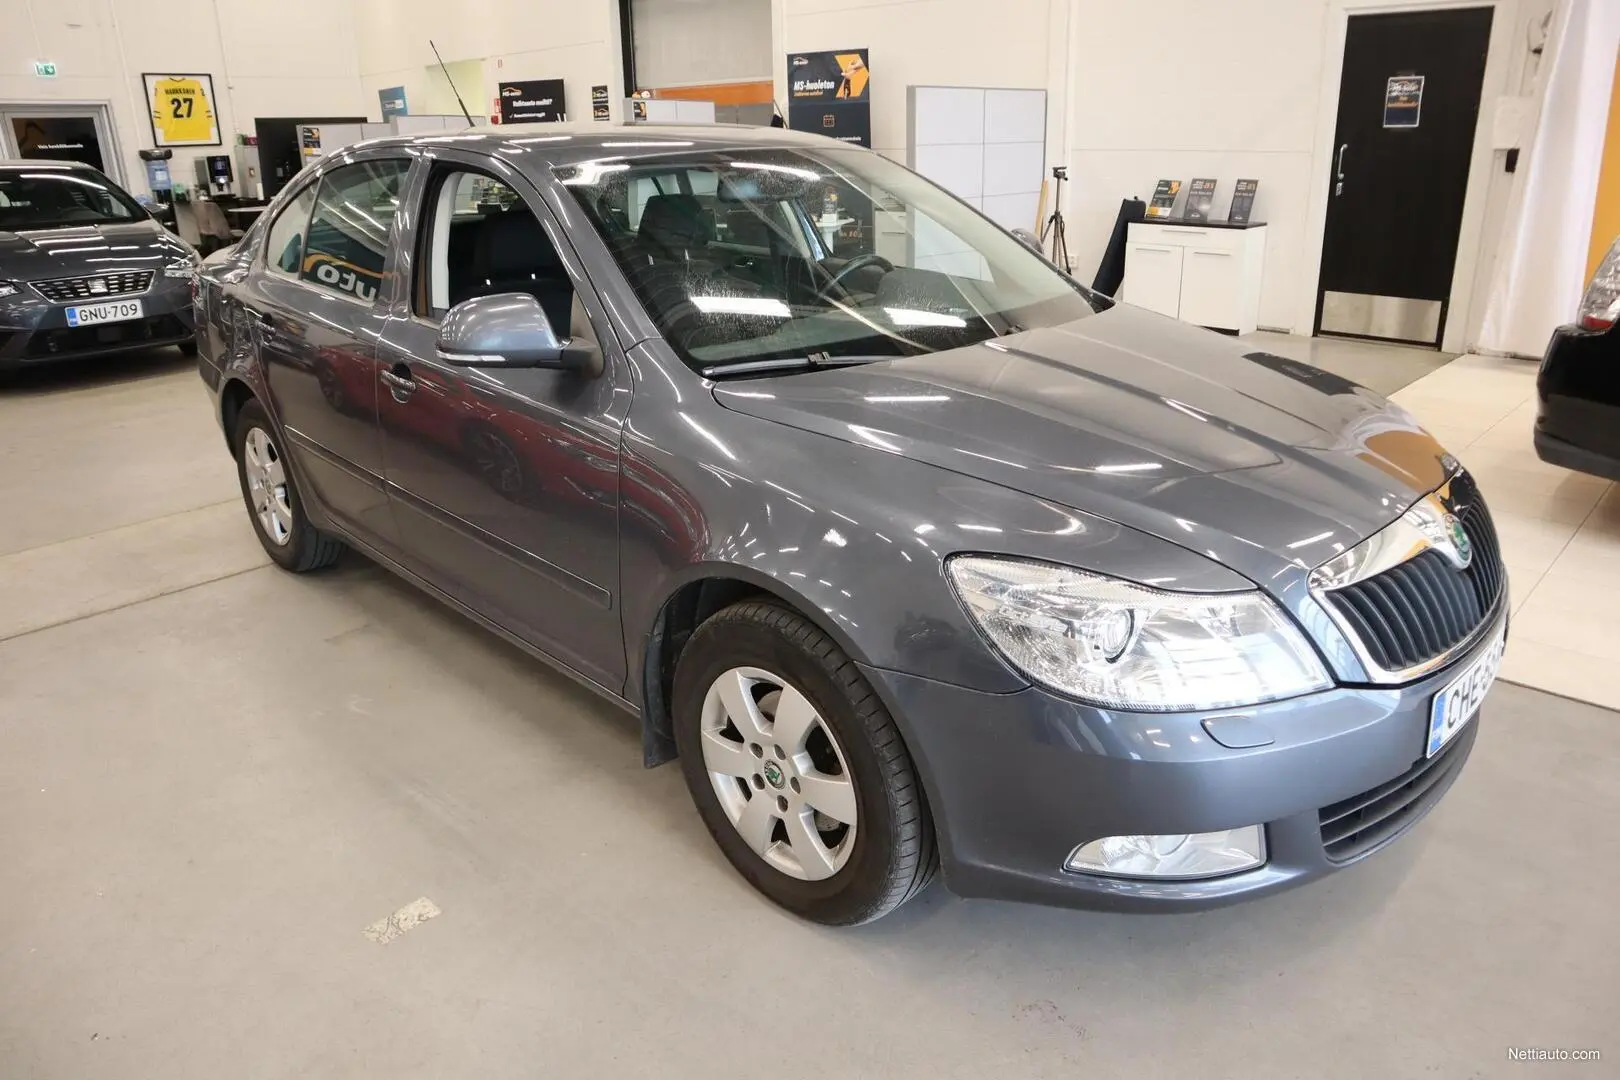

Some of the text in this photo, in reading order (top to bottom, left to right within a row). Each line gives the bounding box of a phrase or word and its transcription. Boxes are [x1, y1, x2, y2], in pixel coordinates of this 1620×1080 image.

[793, 79, 835, 91] MS-huoleton
[171, 98, 193, 119] 27
[80, 304, 137, 321] GNU-709
